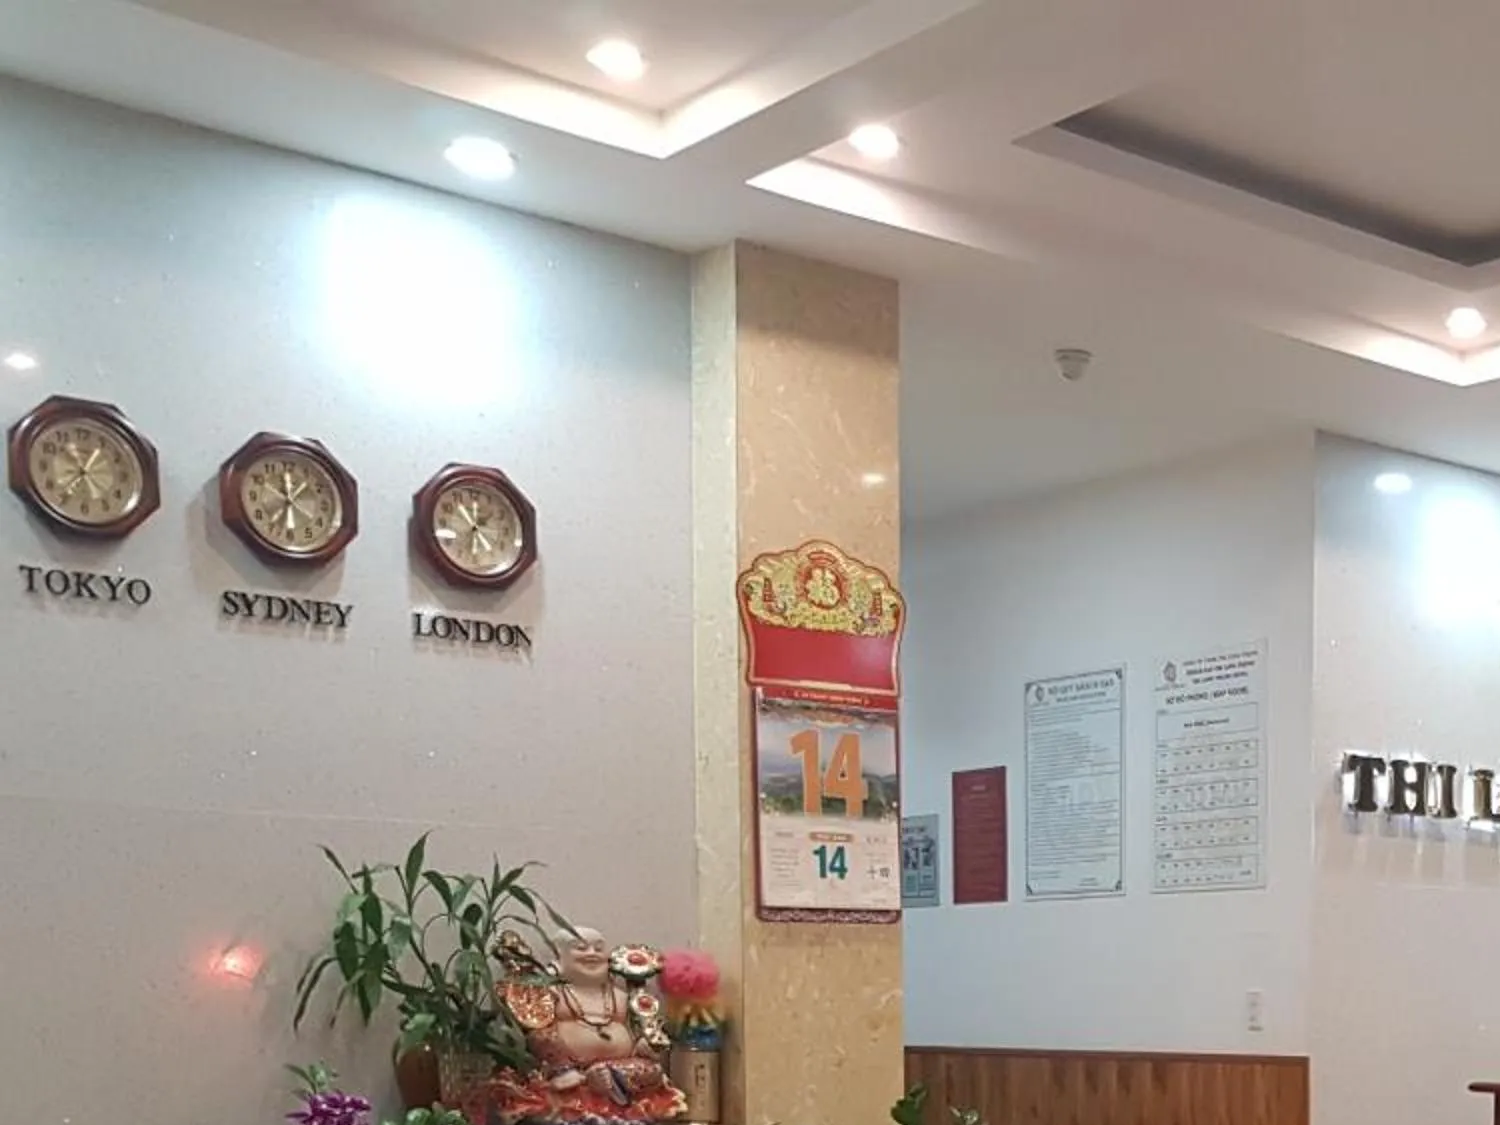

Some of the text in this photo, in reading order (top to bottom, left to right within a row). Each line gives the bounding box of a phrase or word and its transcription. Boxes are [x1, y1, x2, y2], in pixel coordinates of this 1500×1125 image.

[19, 564, 152, 605] TOKYO
[222, 589, 353, 629] SYDNEY
[413, 612, 533, 648] LONDON
[789, 727, 869, 819] 14
[1341, 752, 1457, 820] THI
[812, 844, 849, 881] 14
